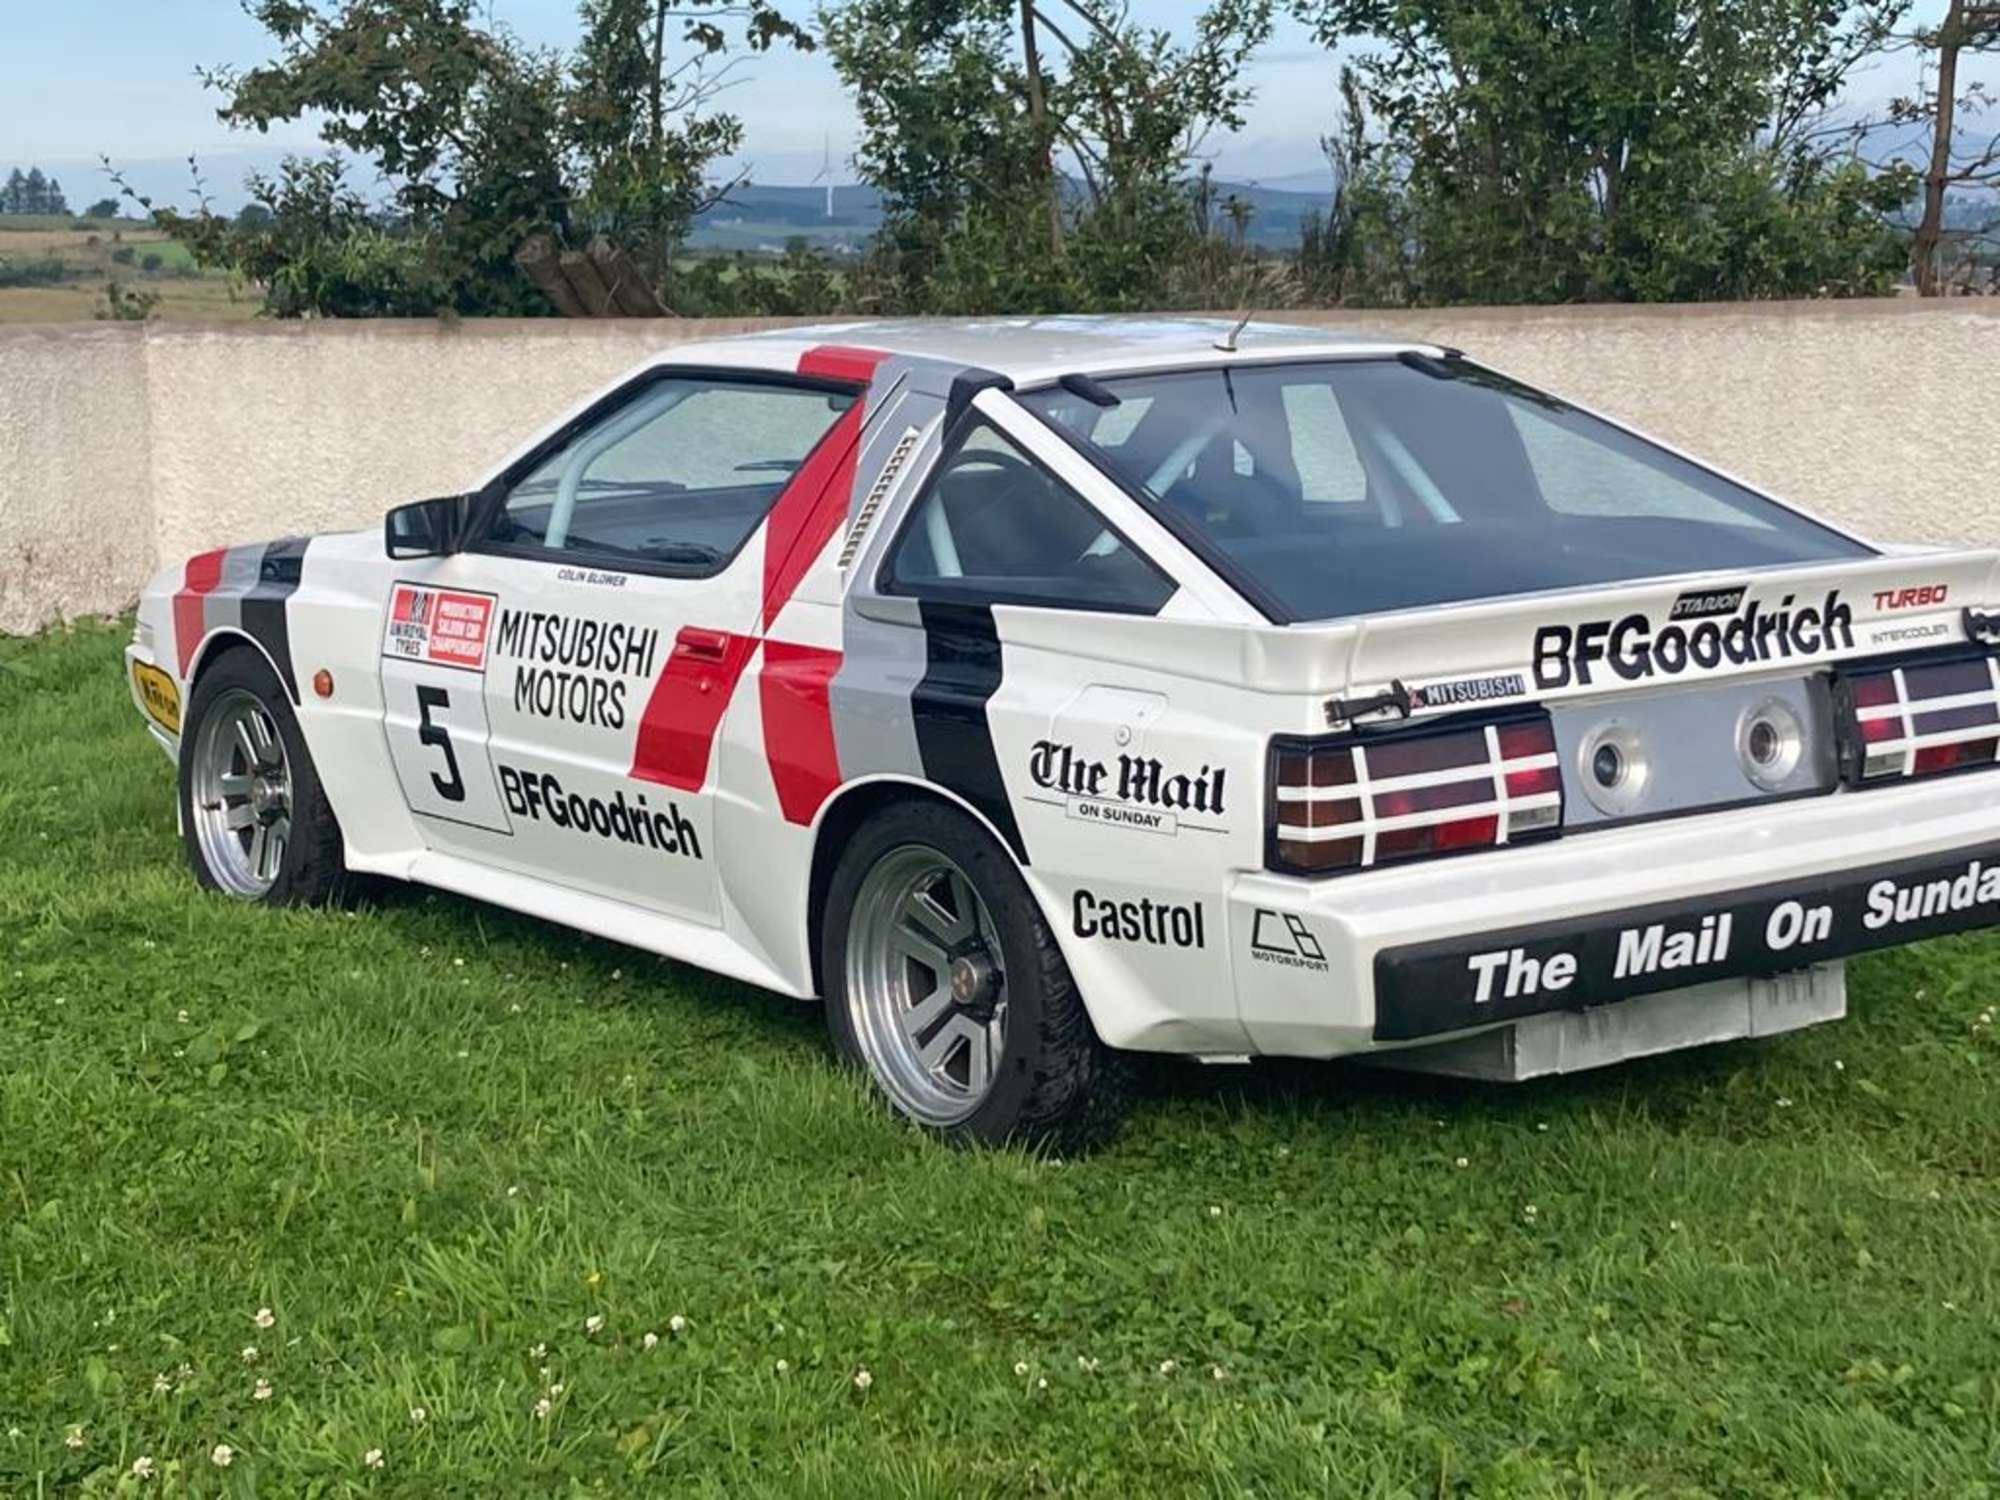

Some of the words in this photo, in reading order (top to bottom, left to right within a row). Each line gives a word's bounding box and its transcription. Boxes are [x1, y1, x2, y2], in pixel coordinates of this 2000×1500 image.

[1873, 585, 1948, 610] TURBO
[395, 638, 421, 657] TYRES
[496, 609, 659, 678] MITSUBISHI
[1533, 589, 1855, 691] BFGoodrich
[1871, 624, 1949, 644] INTERCOOLER
[514, 666, 626, 730] MOTORS
[1425, 674, 1526, 705] MITSUBISHI
[416, 684, 466, 802] 5
[1030, 740, 1108, 795] The
[1117, 753, 1226, 815] Mail
[498, 764, 703, 860] BFGoodrich
[1079, 803, 1101, 818] ON
[1104, 806, 1162, 828] SUNDAY
[1072, 889, 1205, 949] Castrol
[1251, 950, 1329, 973] MOTORSPORT
[1467, 948, 1577, 1002] The
[1612, 912, 1732, 979] Mail
[1765, 901, 1833, 950] On
